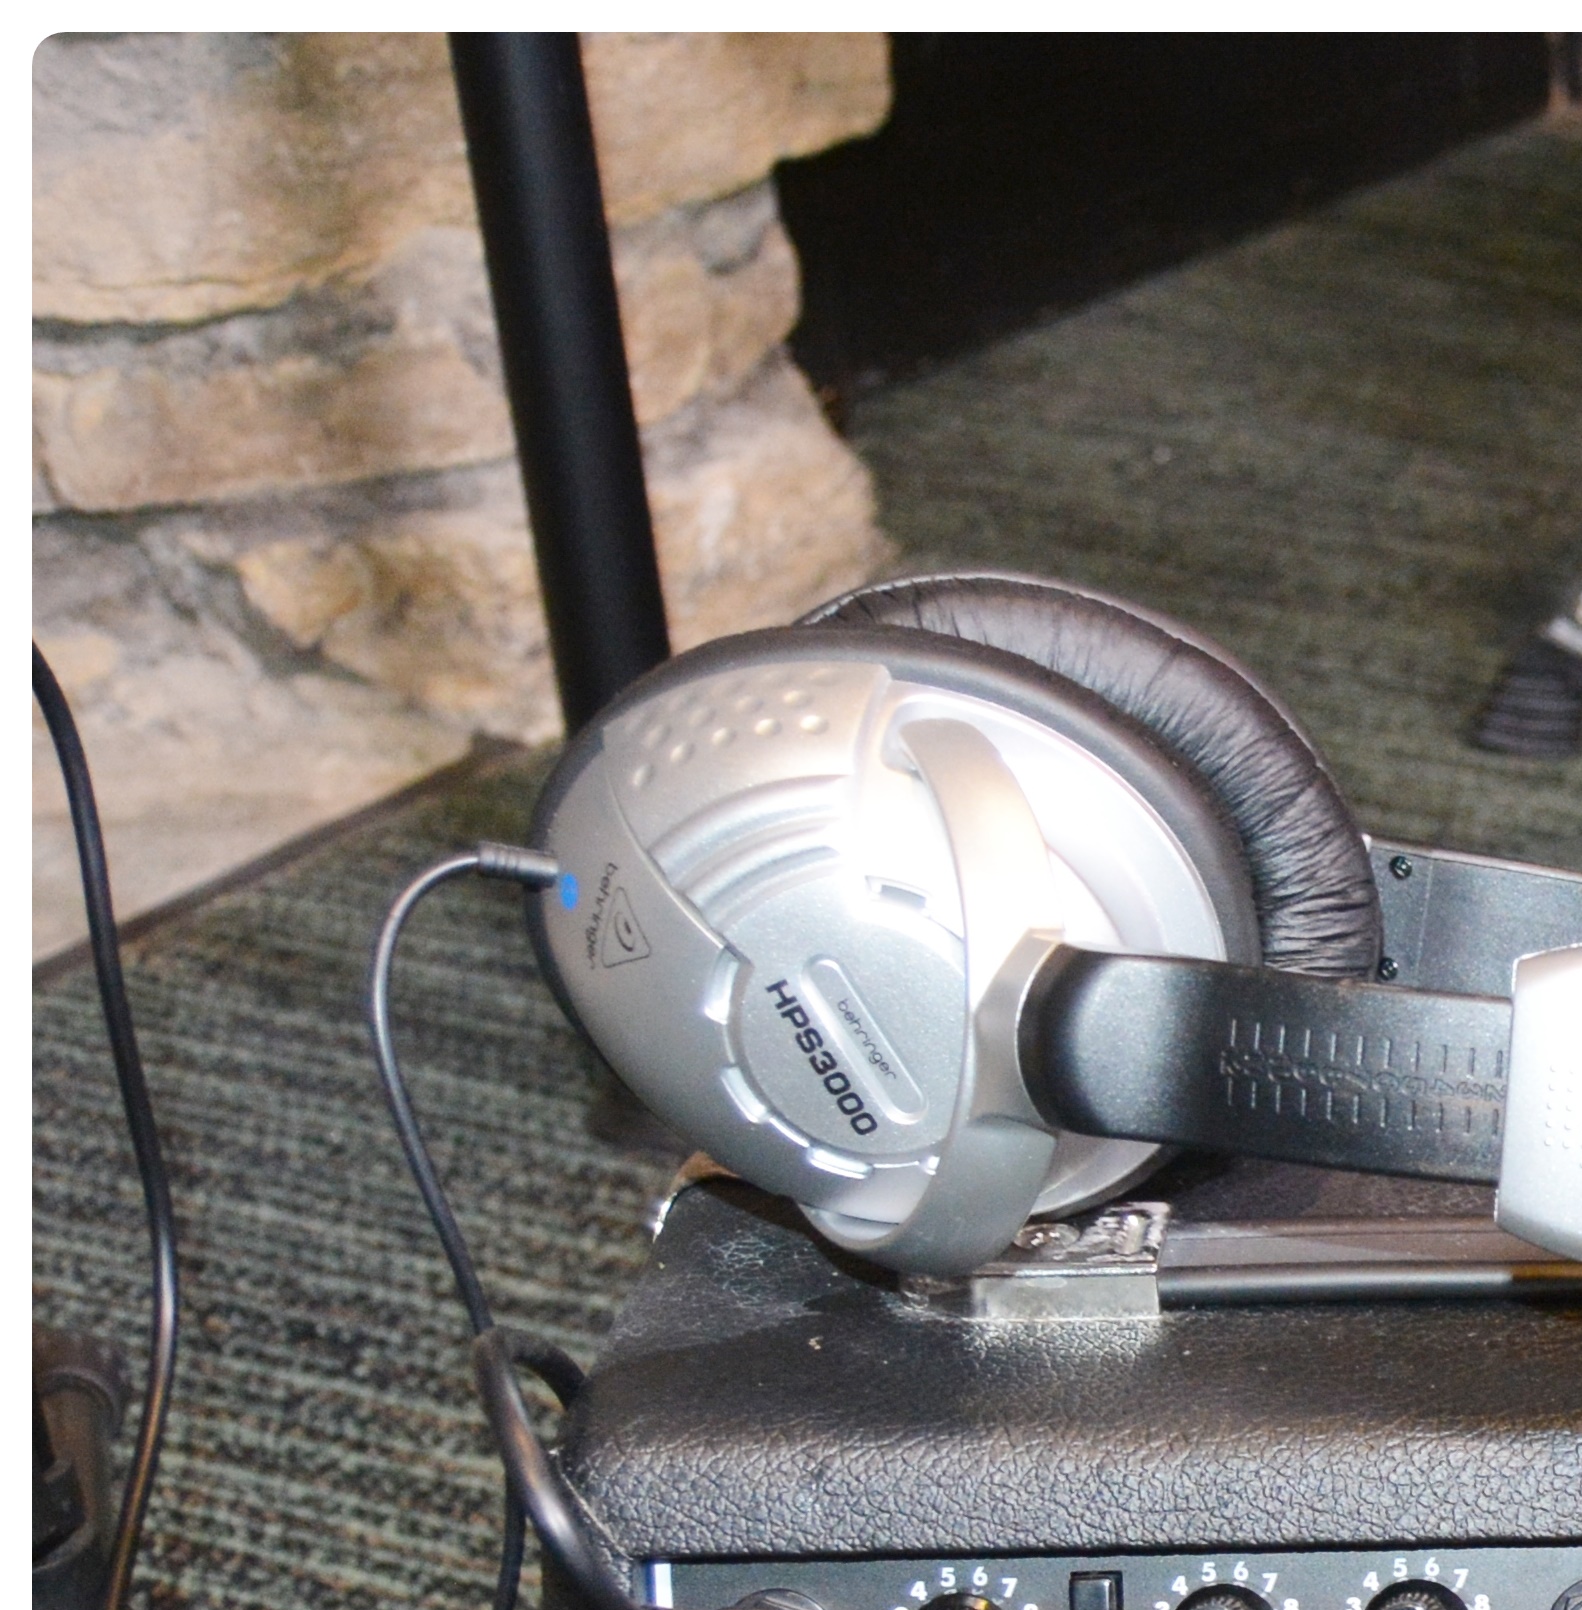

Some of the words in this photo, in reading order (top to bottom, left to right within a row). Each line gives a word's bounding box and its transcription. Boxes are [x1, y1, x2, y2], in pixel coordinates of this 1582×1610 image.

[766, 979, 877, 1135] HPS3000
[838, 999, 896, 1080] behringer
[910, 1581, 927, 1601] 4
[941, 1568, 955, 1587] 5
[973, 1566, 988, 1586] 6
[1001, 1578, 1018, 1597] 7
[1172, 1576, 1188, 1595] 4
[1202, 1562, 1217, 1581] 5
[1234, 1561, 1248, 1581] 6
[1262, 1573, 1278, 1592] 7
[1363, 1572, 1379, 1591] 4
[1393, 1558, 1407, 1577] 5
[1425, 1557, 1439, 1577] 6
[1453, 1569, 1469, 1588] 7
